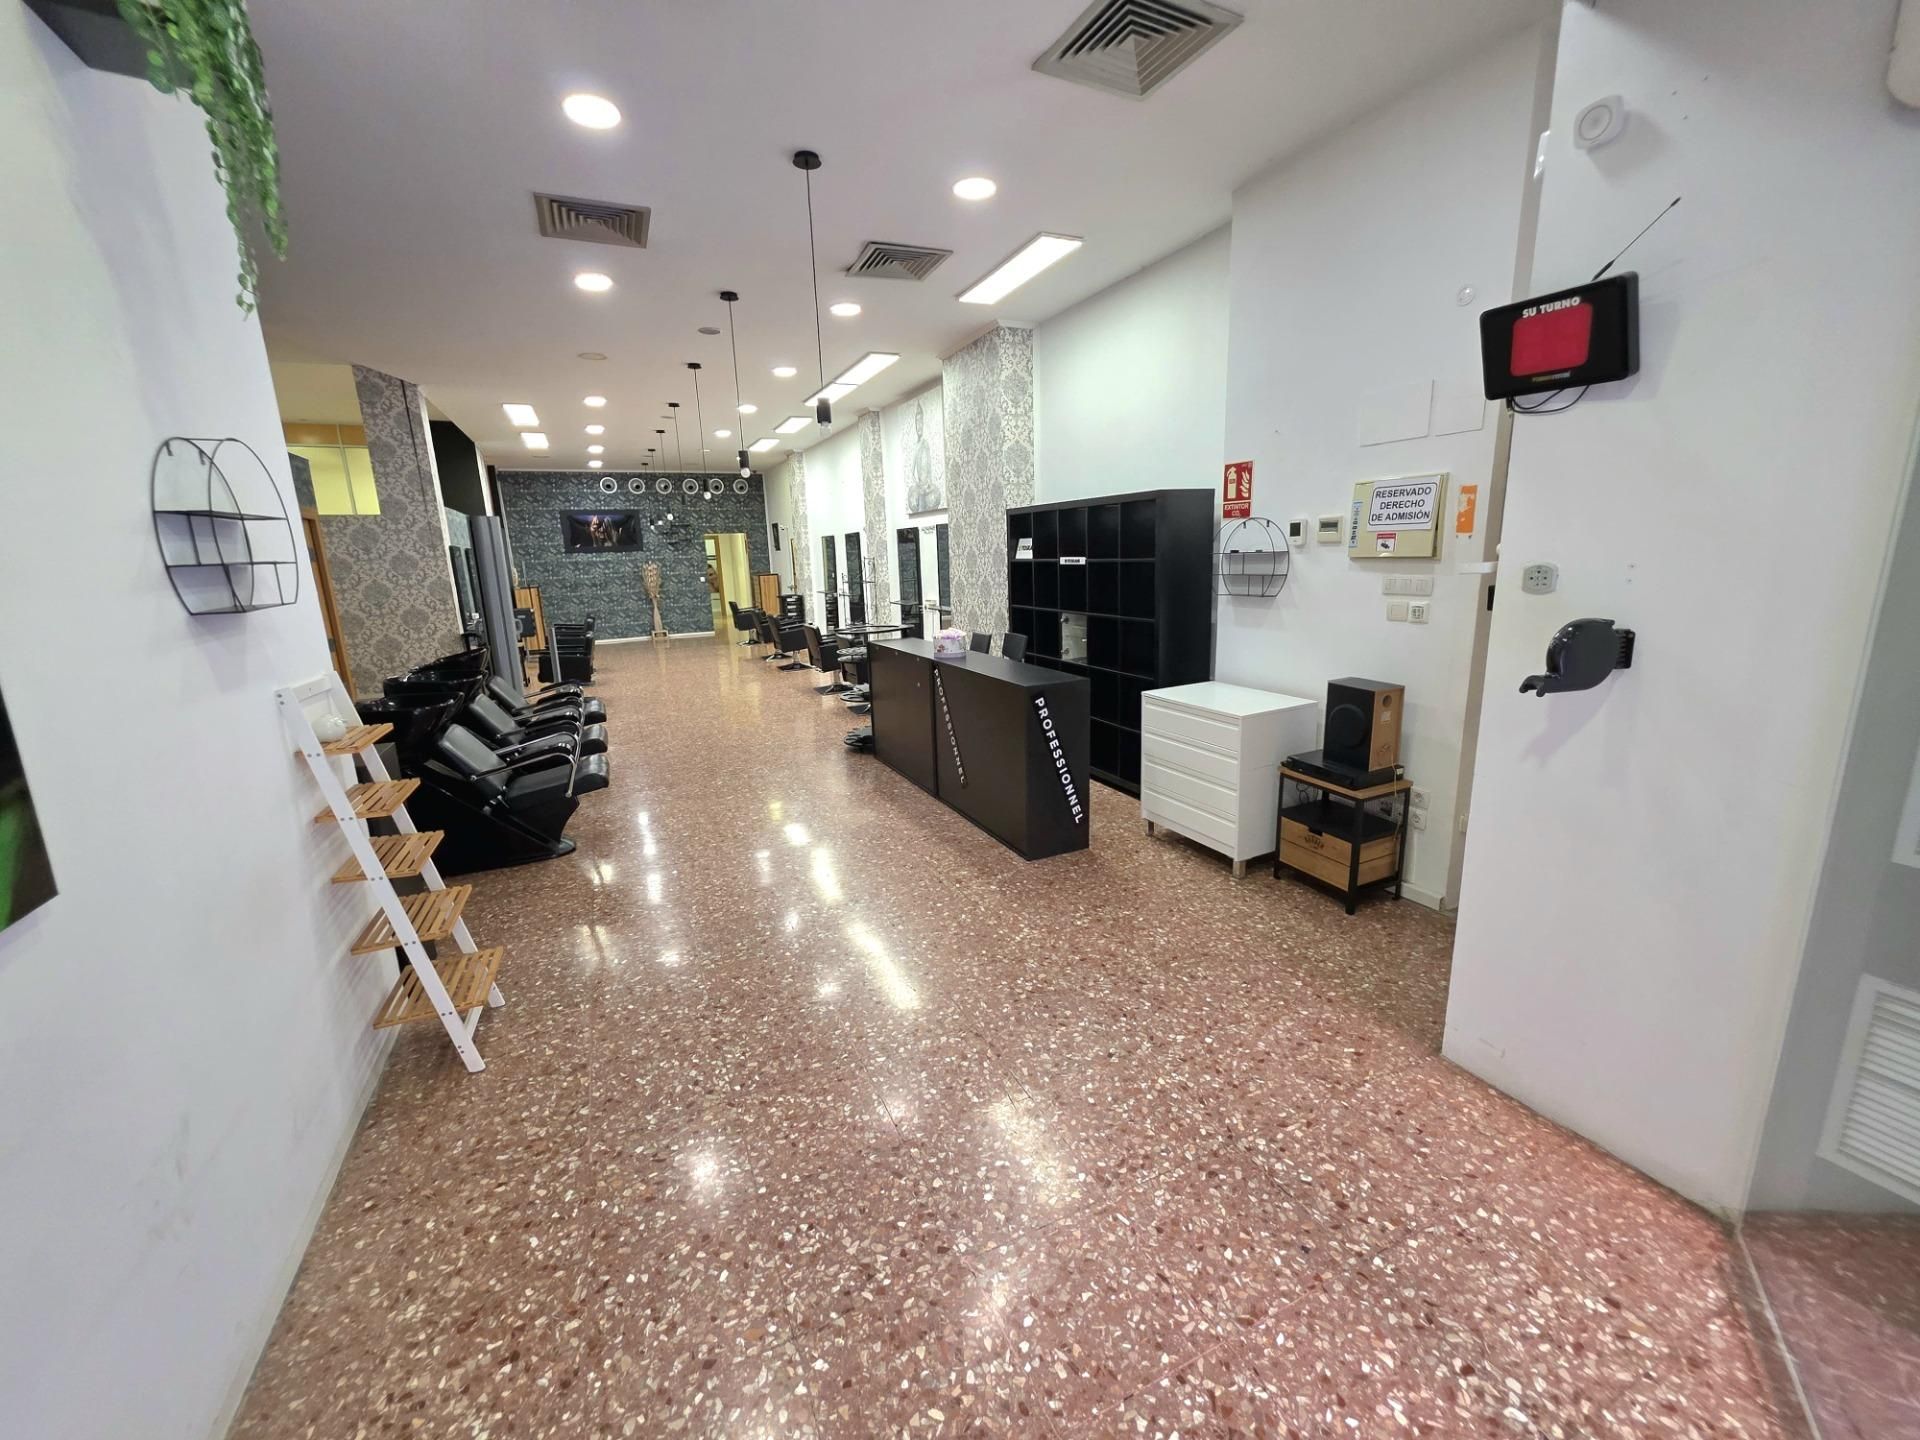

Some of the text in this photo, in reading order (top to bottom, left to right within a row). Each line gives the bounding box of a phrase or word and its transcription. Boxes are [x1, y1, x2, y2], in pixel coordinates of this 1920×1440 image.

[1522, 296, 1580, 318] SU TURNO
[1375, 486, 1432, 499] RESERVADO
[1379, 499, 1425, 510] DERECHO
[1371, 510, 1431, 521] DE ADMISIÓN
[933, 668, 965, 784] PROFESSIONNEL
[1035, 697, 1083, 824] PROFESSIONNEL
